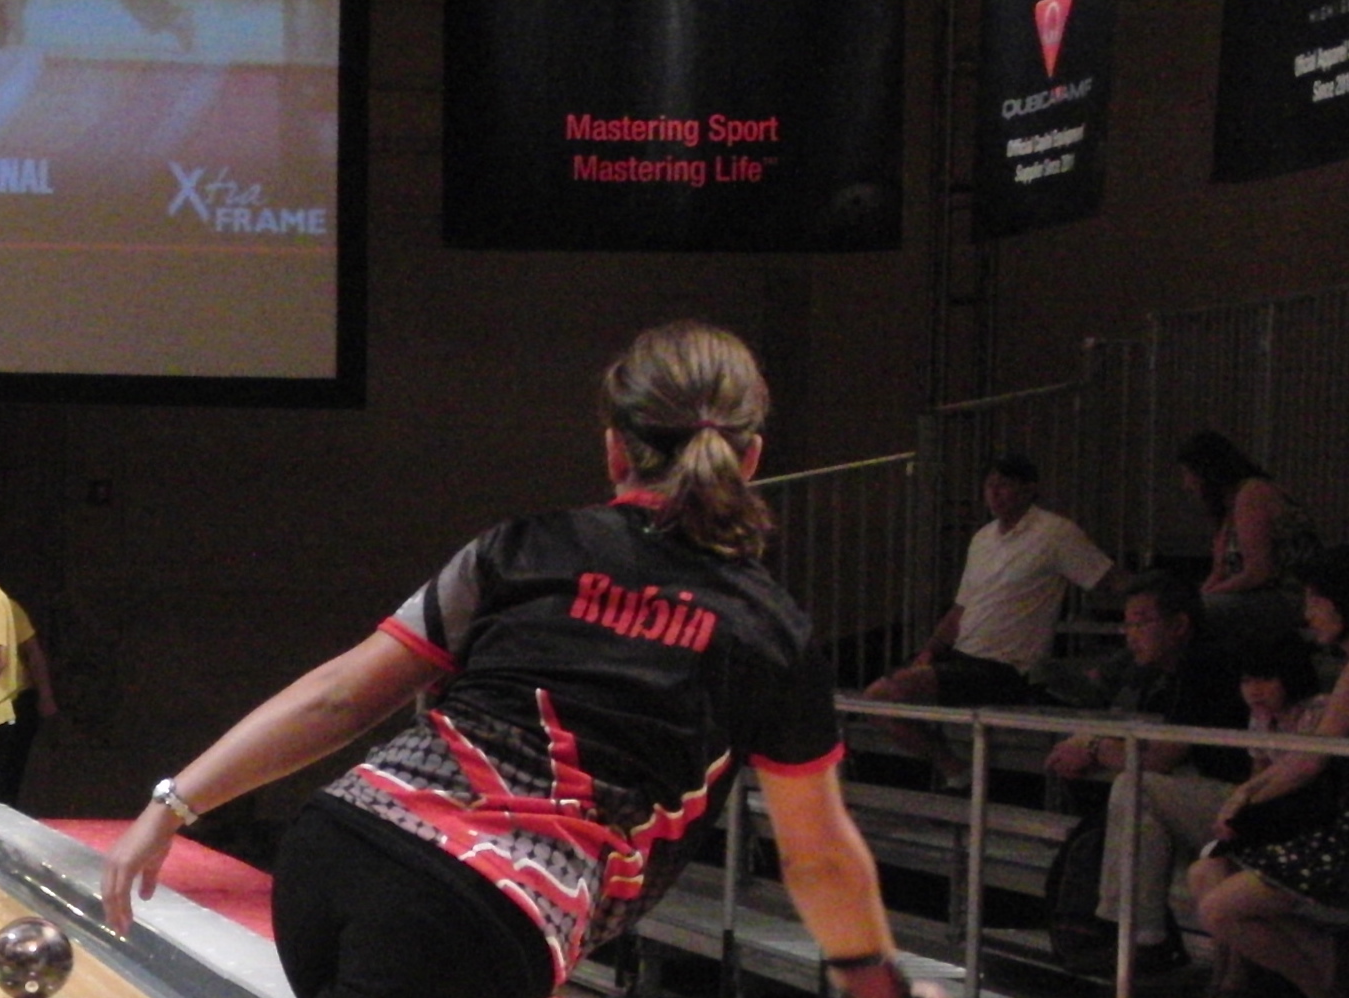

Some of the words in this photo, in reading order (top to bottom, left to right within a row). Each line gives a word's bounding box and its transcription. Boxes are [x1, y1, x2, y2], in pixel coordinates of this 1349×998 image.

[566, 113, 700, 147] Mastering
[708, 114, 779, 146] Sport
[573, 155, 706, 187] Mastering
[215, 207, 328, 235] FRAME
